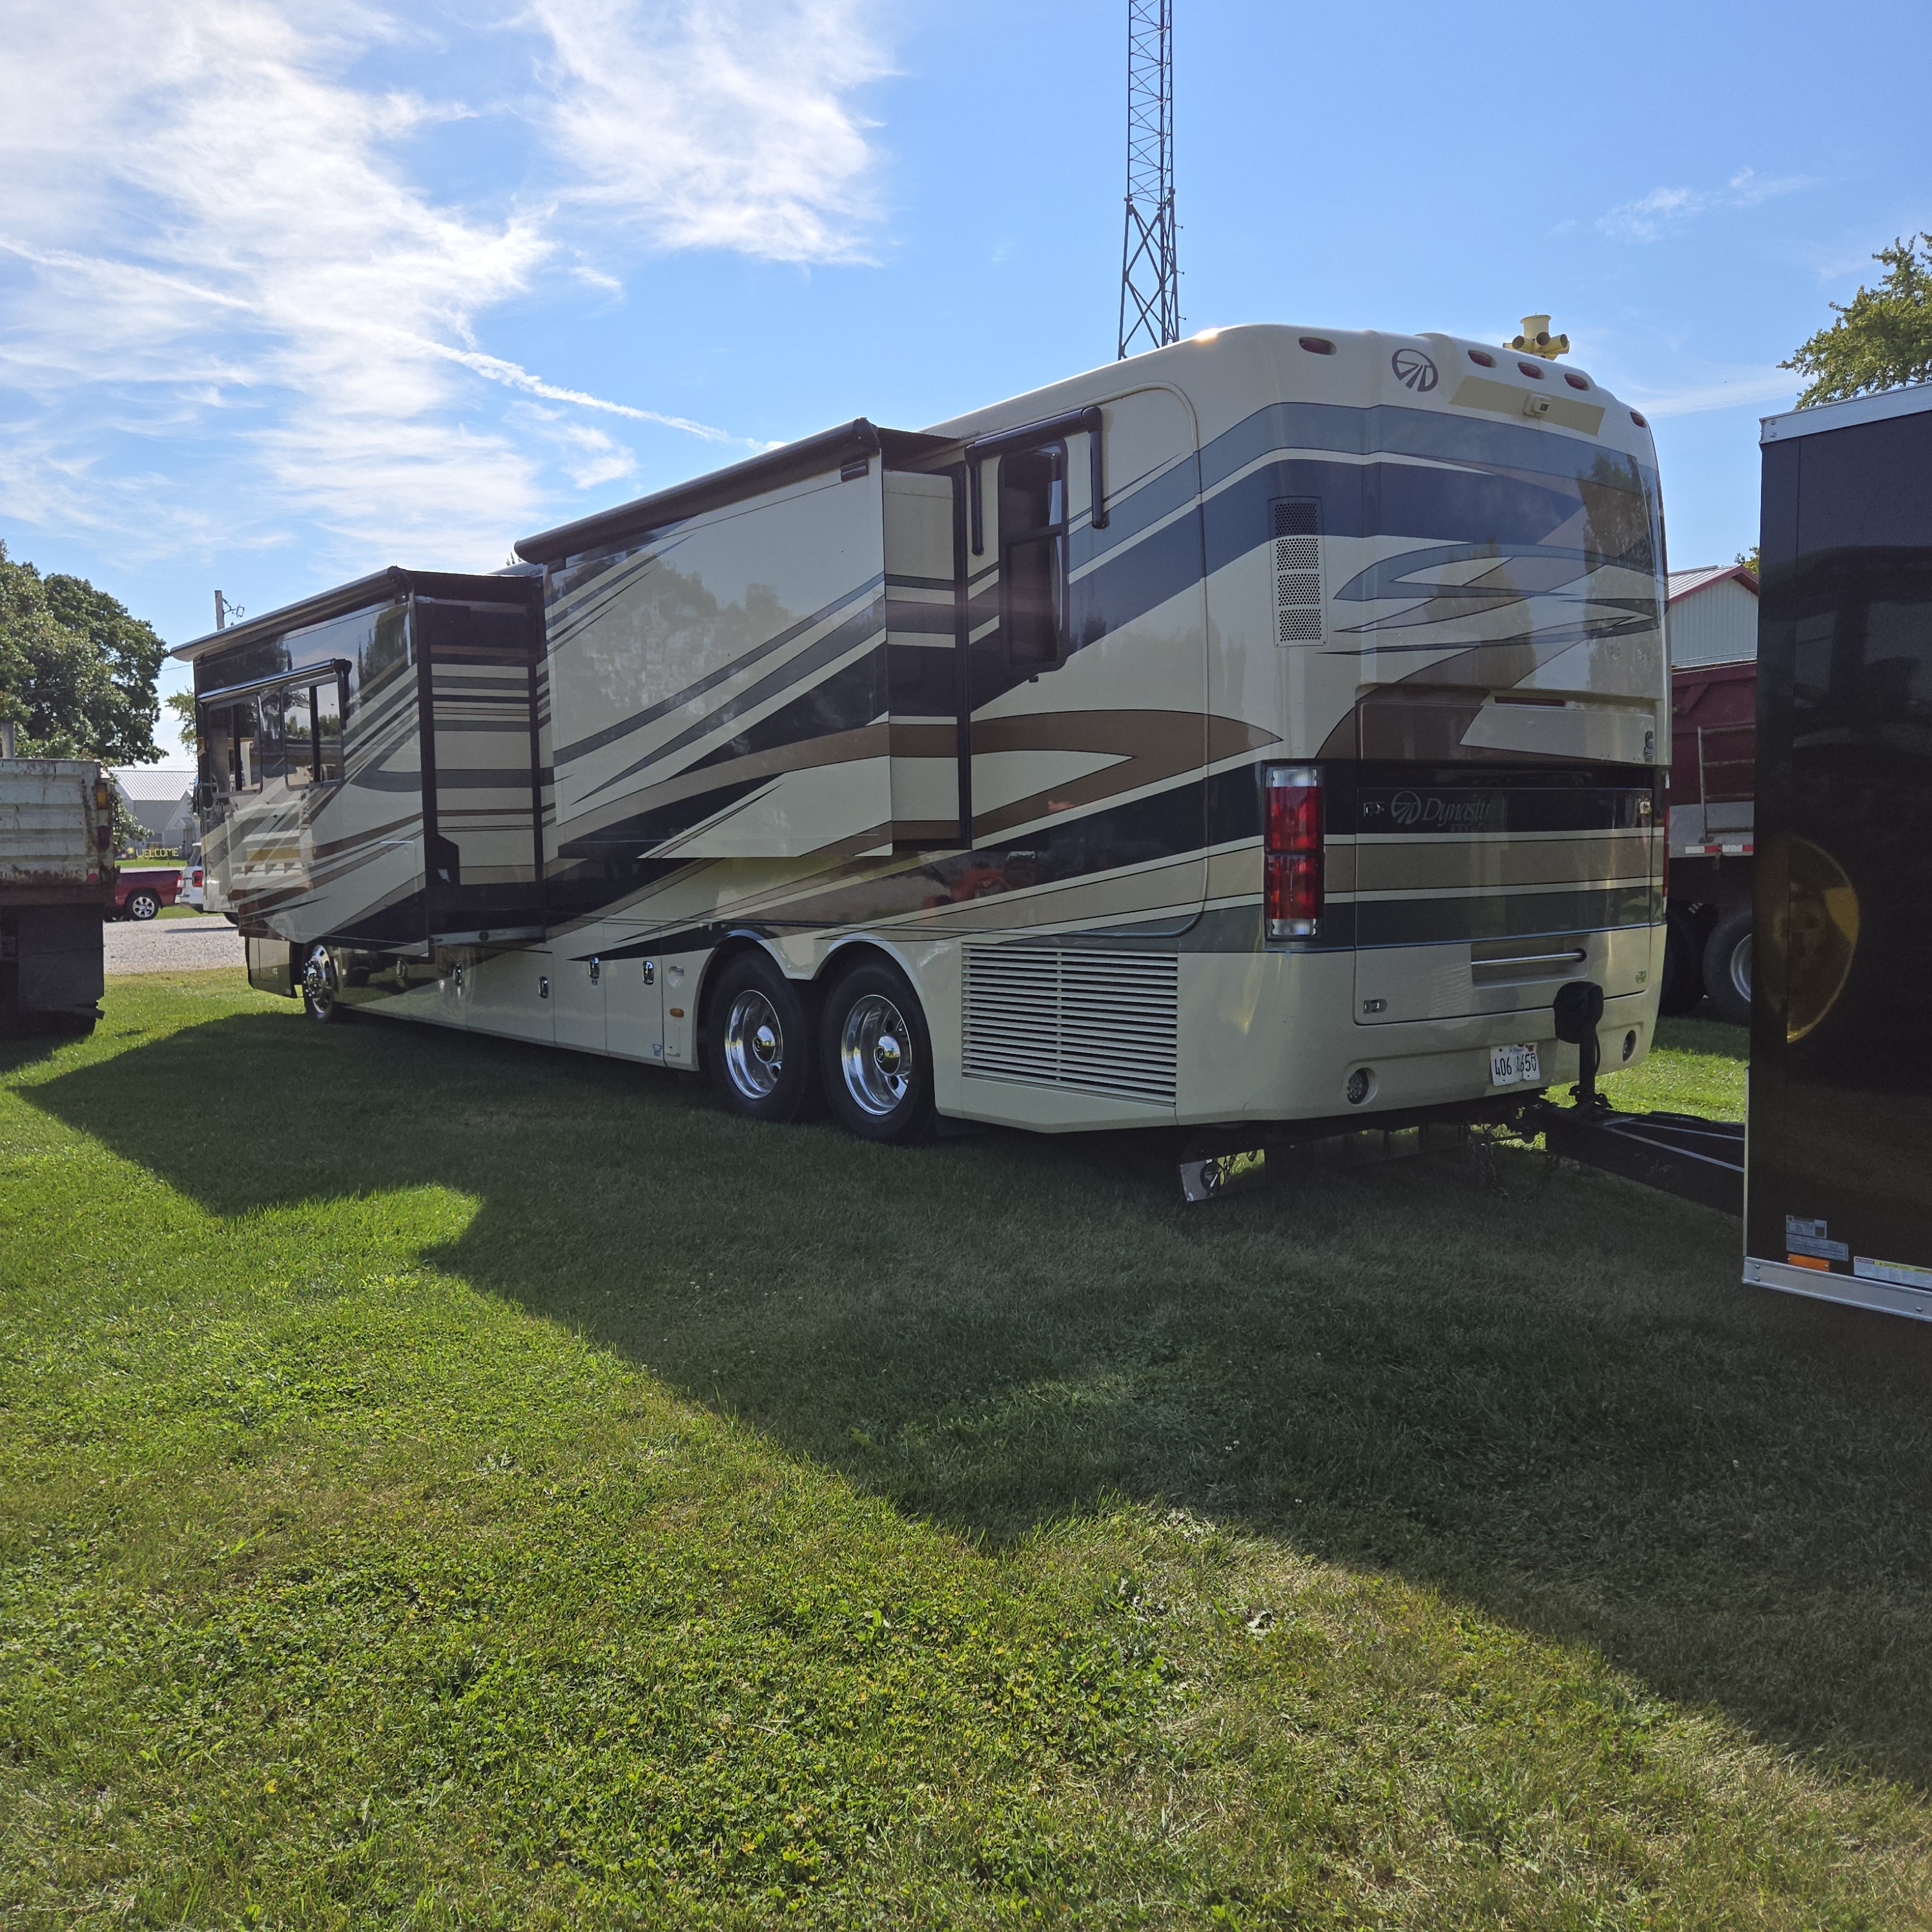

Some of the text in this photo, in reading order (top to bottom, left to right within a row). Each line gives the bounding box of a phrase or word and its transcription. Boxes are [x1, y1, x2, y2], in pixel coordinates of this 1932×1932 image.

[1421, 798, 1490, 827] Dynasty
[136, 848, 179, 858] WELCOME
[1495, 1058, 1512, 1076] 406
